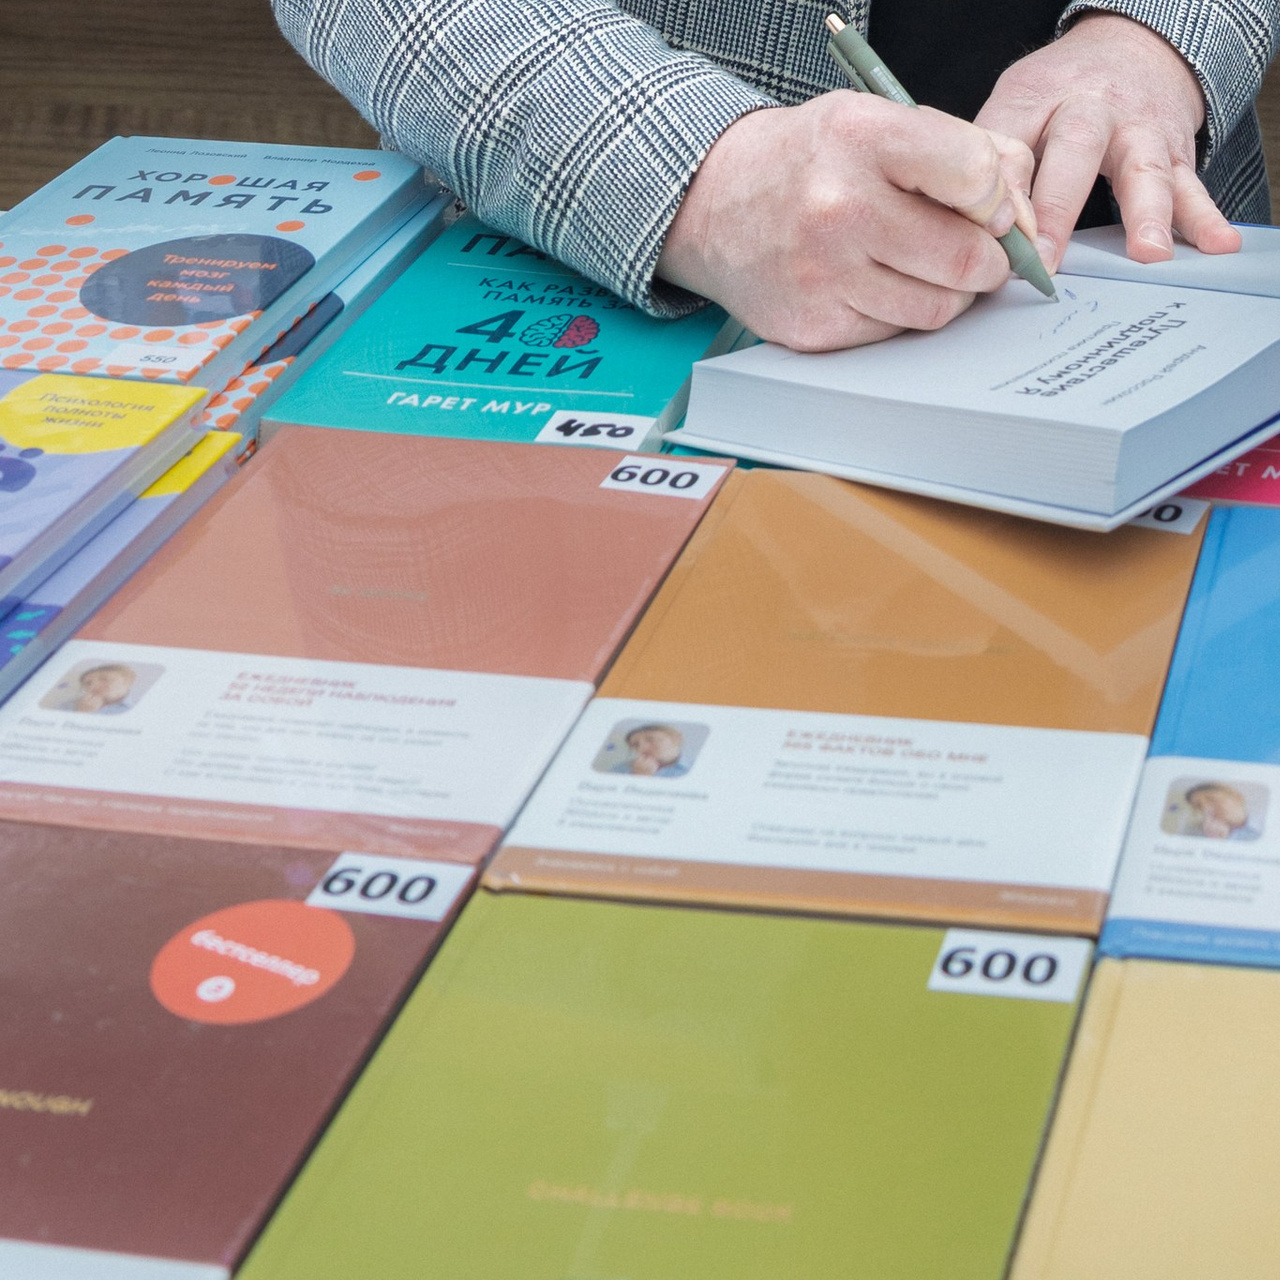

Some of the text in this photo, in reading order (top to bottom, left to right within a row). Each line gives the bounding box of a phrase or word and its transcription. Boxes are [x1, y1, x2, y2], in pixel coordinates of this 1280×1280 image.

[145, 147, 187, 156] Леонид
[263, 154, 318, 164] Владимир
[72, 184, 334, 215] ПАМЯТЬ
[162, 252, 279, 271] Тренируем
[179, 268, 231, 280] мозг
[478, 277, 536, 291] КАК
[146, 278, 235, 294] каждый
[146, 290, 202, 305] день
[482, 289, 594, 309] ПАМЯТЬ
[1037, 311, 1169, 385] подлинному
[139, 354, 179, 365] 550
[394, 342, 605, 380] ДНЕЙ
[1039, 318, 1188, 399] Путешествие
[1015, 385, 1042, 397] Я
[38, 391, 156, 413] Психология
[387, 391, 554, 417] ГАРЕТ МУР
[41, 415, 106, 429] жизни
[42, 404, 129, 421] полноты
[554, 417, 636, 441] 450
[610, 463, 700, 490] 600
[321, 868, 437, 905] 600
[938, 945, 1059, 988] 600
